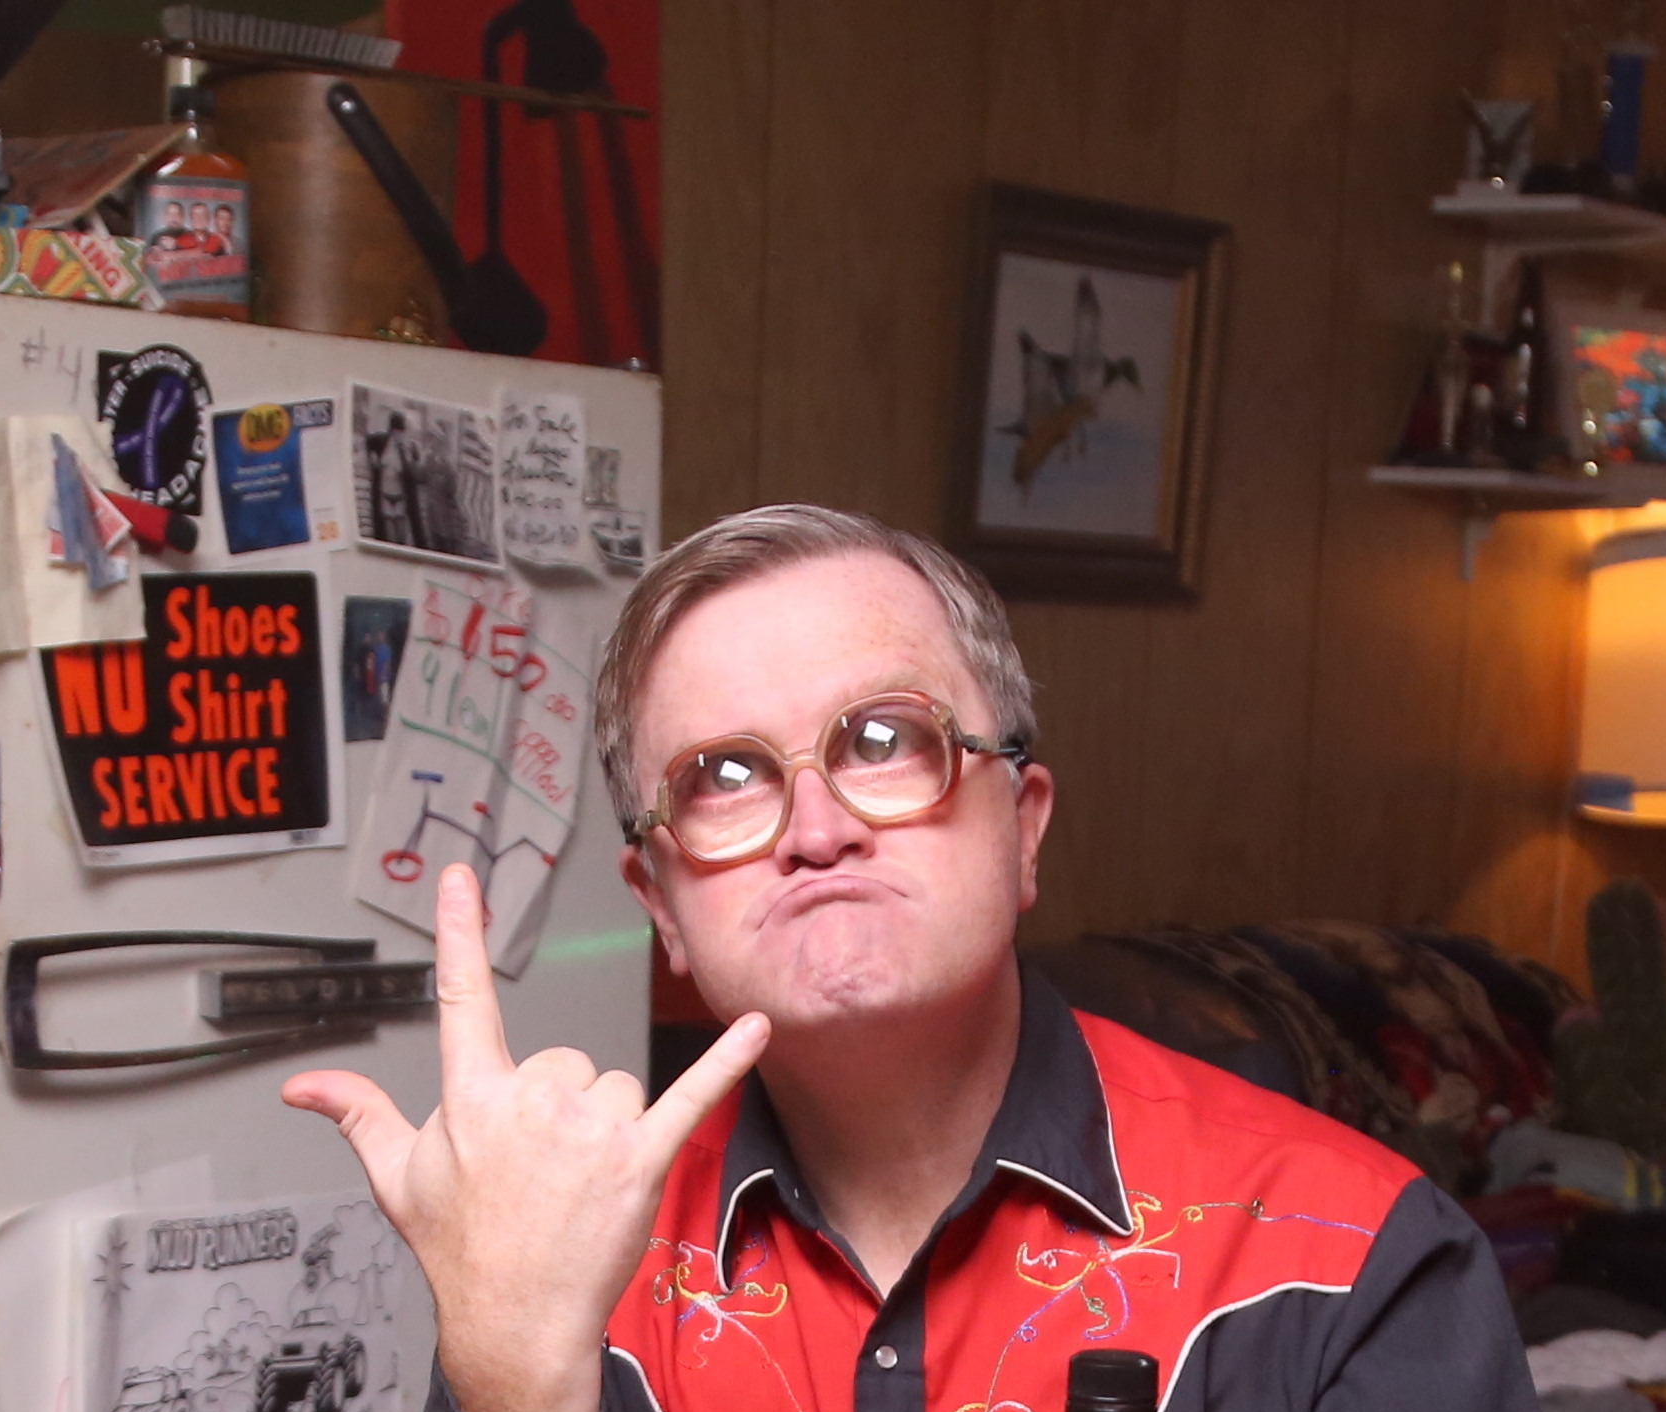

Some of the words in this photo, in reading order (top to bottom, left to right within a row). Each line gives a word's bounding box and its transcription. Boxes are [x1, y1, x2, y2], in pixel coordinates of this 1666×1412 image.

[165, 584, 301, 660] Shoes
[53, 641, 148, 736] NO
[168, 668, 288, 745] Shirt
[92, 747, 282, 829] SERVICE
[147, 1222, 197, 1273] MUD
[201, 1210, 299, 1271] RUNNERS
